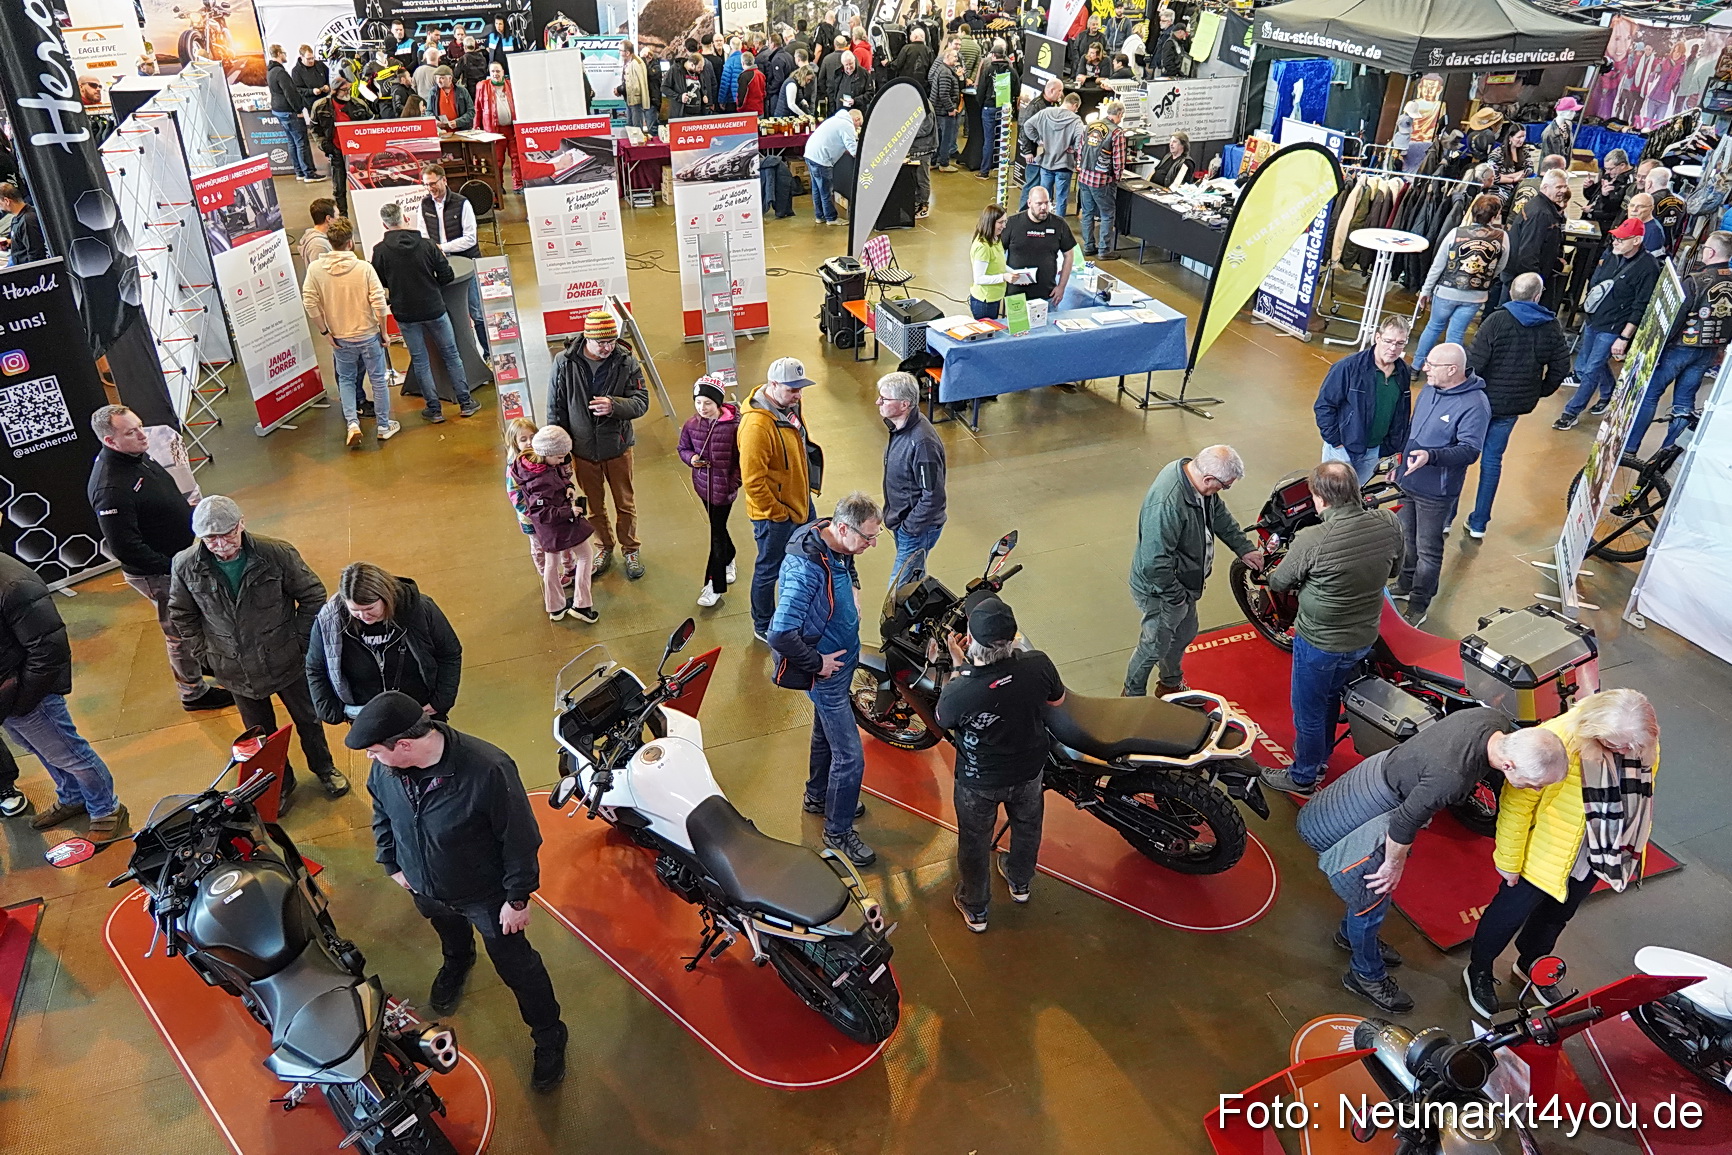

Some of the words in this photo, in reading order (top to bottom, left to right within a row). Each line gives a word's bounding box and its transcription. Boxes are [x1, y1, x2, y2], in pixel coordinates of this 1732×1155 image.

[1272, 30, 1382, 60] dax-stickservice.de
[1446, 48, 1575, 66] dax-stickservice.de
[1152, 86, 1181, 119] DAX
[354, 124, 423, 136] OLDTIMER-GUTACHTEN
[520, 122, 606, 135] SACHVERSTÄNDIGENBEREICH
[681, 120, 747, 132] FUHRPARKMANAGEMENT
[869, 105, 924, 170] KURZENDORFER
[1245, 179, 1334, 247] KURZENDORFER
[2, 273, 59, 301] Herold
[566, 288, 604, 300] DORRER
[567, 280, 599, 292] JANDA
[9, 311, 47, 333] uns!
[268, 348, 292, 369] JANDA
[269, 356, 297, 379] DORRER
[13, 431, 78, 460] @autoherold
[1185, 631, 1258, 654] Racing
